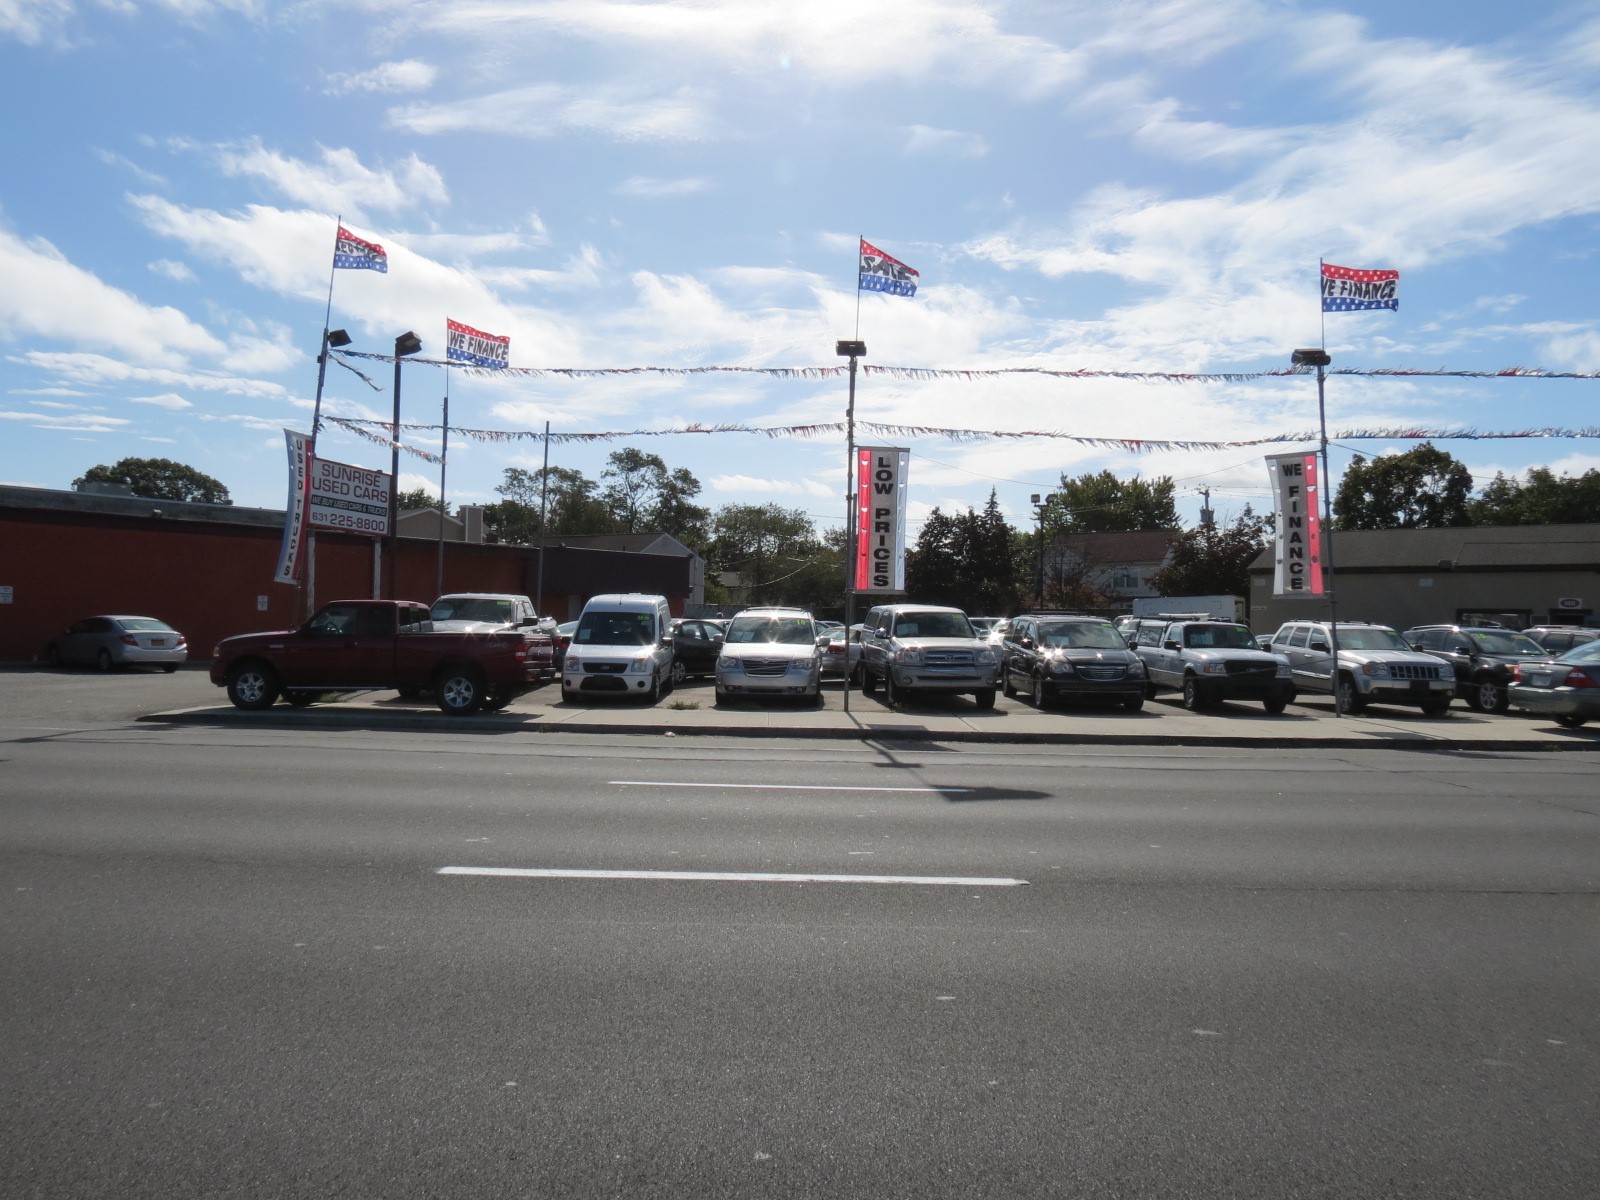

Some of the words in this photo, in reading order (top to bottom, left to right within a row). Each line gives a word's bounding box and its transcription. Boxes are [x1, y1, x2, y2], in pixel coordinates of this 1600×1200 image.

[1340, 280, 1396, 300] FINANCE
[450, 330, 466, 350] WE
[468, 336, 509, 361] FINANCE
[296, 439, 304, 491] USED
[321, 463, 381, 488] SUNRISE
[874, 457, 894, 495] LOW
[1282, 463, 1302, 477] WE
[312, 476, 350, 496] USED
[353, 485, 388, 503] CARS
[312, 495, 322, 505] WE
[322, 497, 334, 507] BUY
[334, 499, 349, 510] USED
[349, 502, 363, 512] CARS
[368, 505, 387, 516] TRUCKS
[312, 511, 328, 523] 631
[330, 513, 385, 532] 225-8800
[283, 499, 302, 577] TRUCKS
[873, 508, 891, 587] PRICES
[1289, 485, 1304, 590] FINANCE
